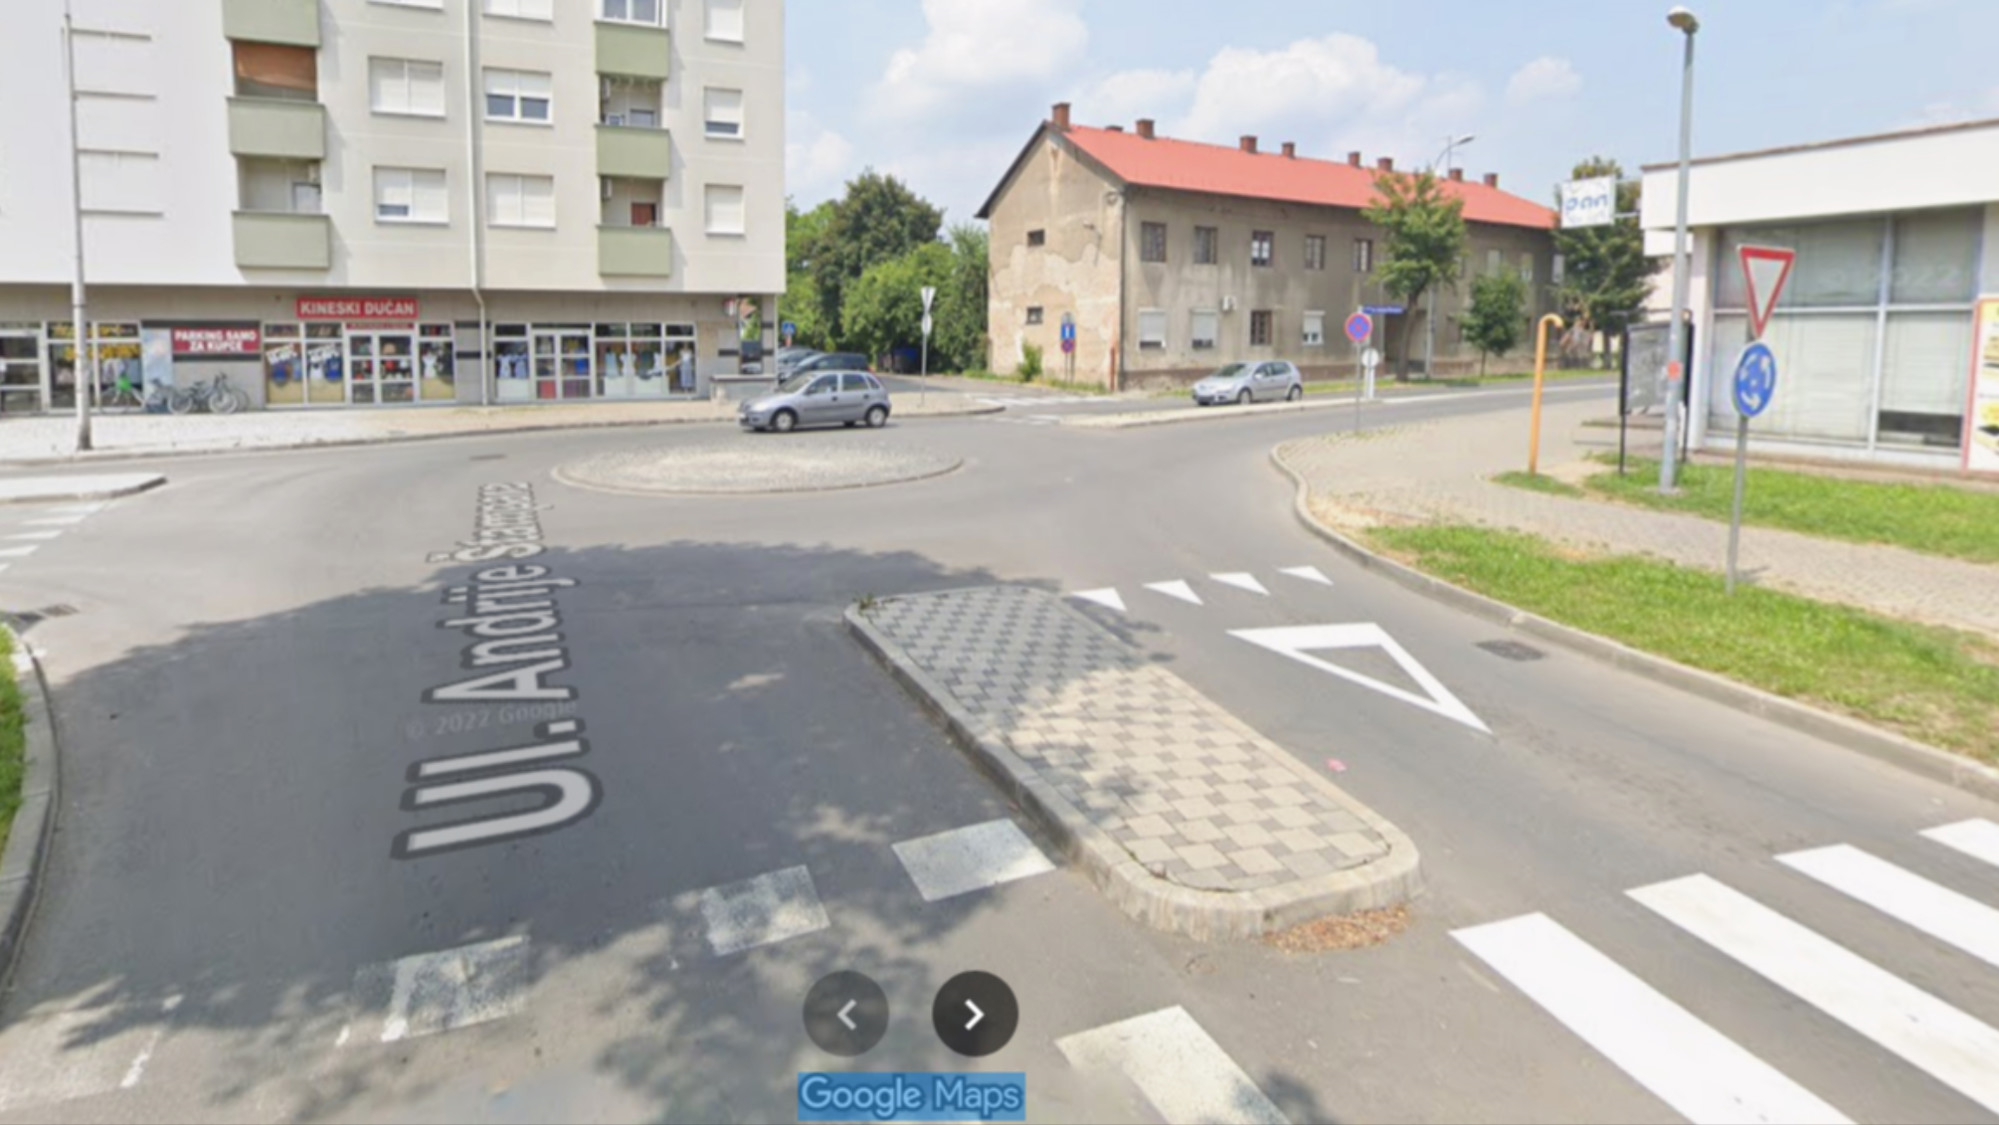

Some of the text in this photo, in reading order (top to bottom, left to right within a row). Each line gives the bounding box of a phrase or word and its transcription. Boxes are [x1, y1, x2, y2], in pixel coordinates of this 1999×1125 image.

[301, 301, 360, 315] KINESKI
[174, 329, 257, 340] PARKING SAMO
[190, 341, 205, 353] ZA
